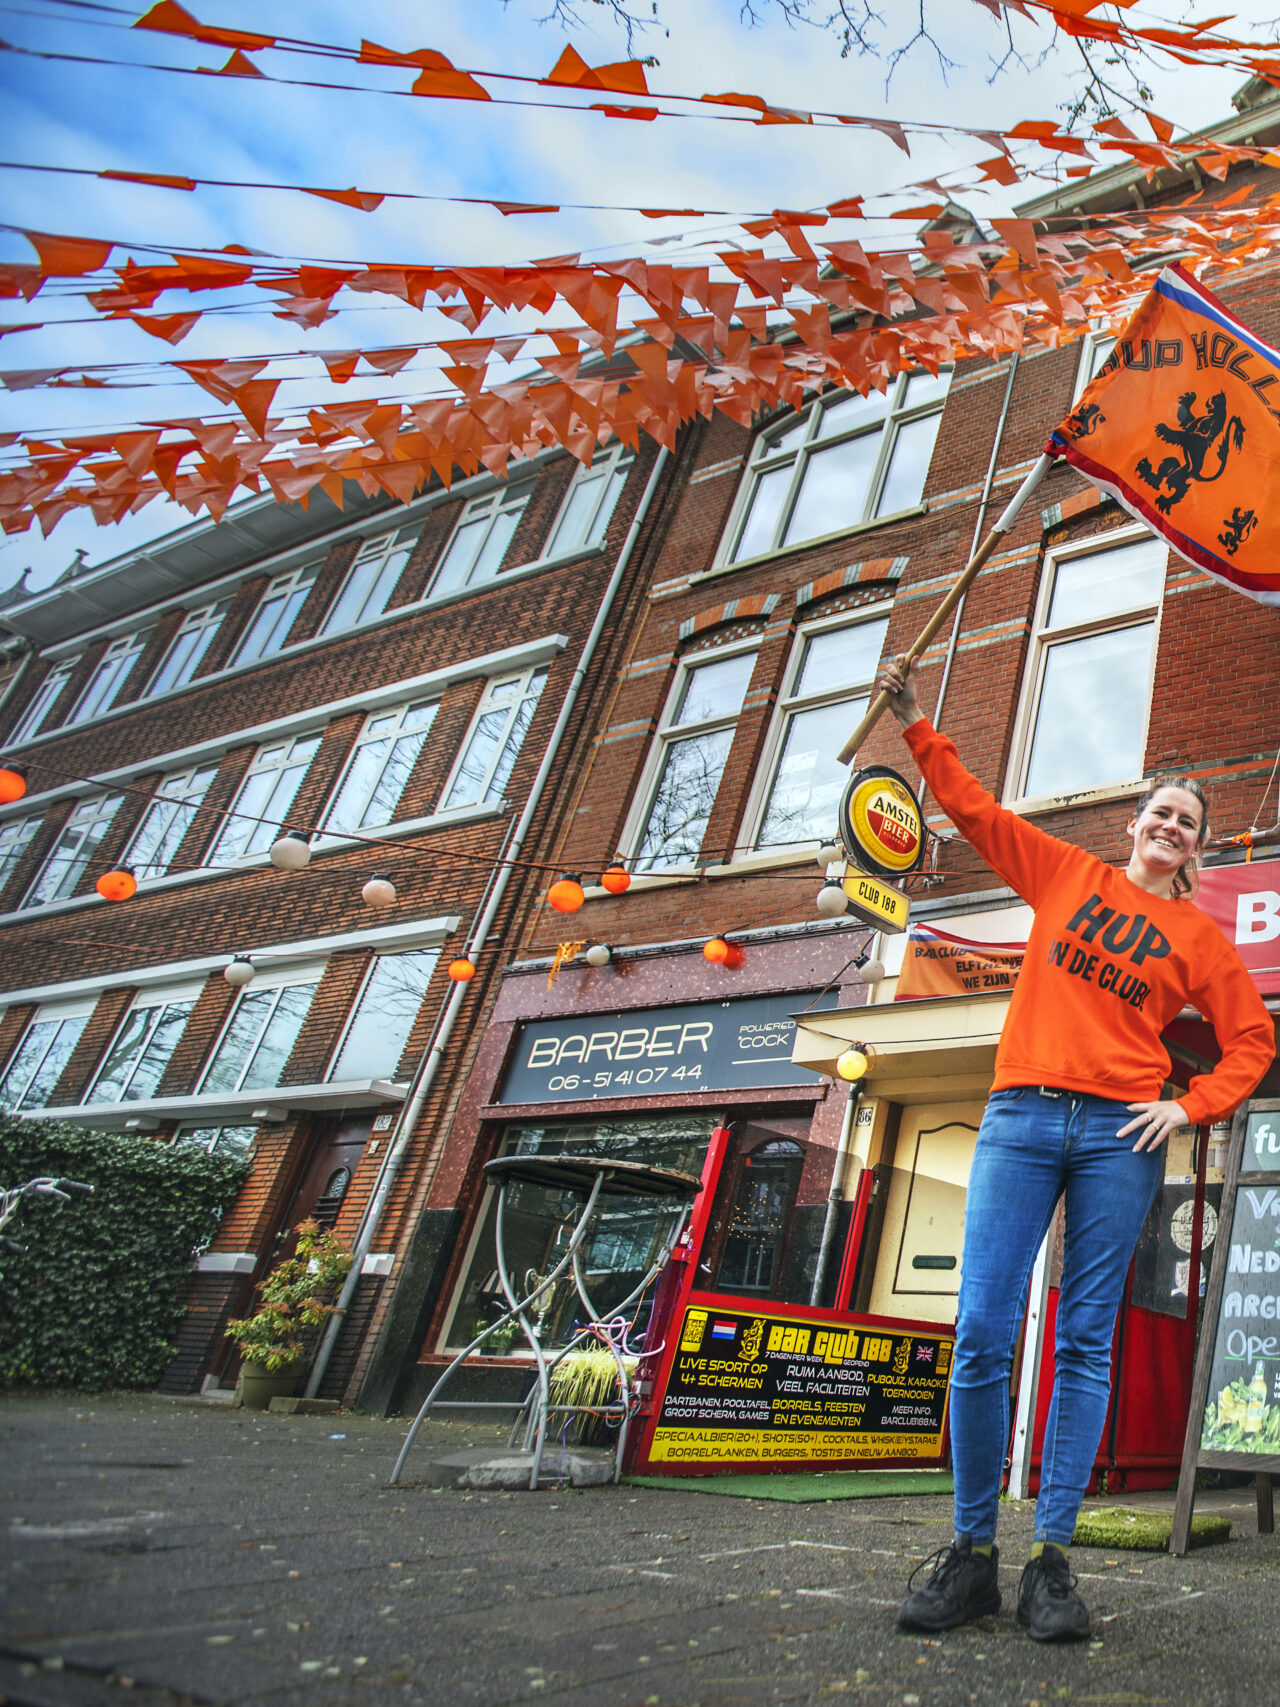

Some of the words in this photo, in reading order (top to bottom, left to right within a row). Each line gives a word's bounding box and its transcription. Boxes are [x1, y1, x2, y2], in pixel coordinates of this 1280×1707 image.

[1095, 338, 1184, 380] HUP
[873, 796, 918, 836] AMSTEL
[884, 819, 910, 843] BIER
[859, 882, 880, 905] CLUB
[881, 895, 897, 914] 188
[1065, 893, 1172, 966] HUP
[938, 946, 967, 958] CLUB
[1048, 940, 1070, 967] IN
[1067, 948, 1099, 982] DE
[962, 976, 980, 989] WE
[983, 973, 1010, 987] ZIJN
[740, 1021, 796, 1033] POWERED
[527, 1022, 713, 1068] BARBER
[635, 1067, 669, 1083] 07
[671, 1064, 702, 1081] 44
[861, 1336, 893, 1363] 188
[680, 1357, 707, 1370] LIVE
[708, 1360, 751, 1373] SPORT
[751, 1363, 768, 1374] OP
[770, 1352, 792, 1360] DAGEN
[792, 1354, 806, 1362] PER
[806, 1355, 824, 1363] WEEK
[843, 1359, 870, 1367] GEOPEND
[681, 1373, 697, 1386] 4+
[698, 1375, 764, 1390] SCHERMEN
[787, 1365, 815, 1378] RUIM
[817, 1367, 865, 1382] AANBOD,
[867, 1373, 906, 1386] PUBQUIZ,
[907, 1377, 948, 1389] KARAOKE
[776, 1380, 805, 1393] VEEL
[806, 1382, 870, 1396] FACILITEITEN
[882, 1388, 935, 1400] TOERNOOIEN
[664, 1395, 722, 1407] DARTBANEN,
[722, 1399, 771, 1410] POOLTAFEL,
[772, 1399, 823, 1413] BORRELS,
[824, 1401, 866, 1413] FEESTEN
[892, 1405, 913, 1415] MEER
[914, 1406, 932, 1415] INFO:
[664, 1408, 697, 1418] GROOT
[698, 1409, 738, 1420] SCHERM,
[738, 1410, 770, 1420] GAMES
[773, 1413, 789, 1425] EN
[790, 1414, 861, 1427] EVENEMENTEN
[881, 1416, 939, 1427] BARCLUB188.NL
[823, 1434, 869, 1445] COCKTAILS,
[667, 1448, 760, 1458] BORRELPLANKEN,
[762, 1448, 809, 1458] BURGERS,
[844, 1448, 856, 1457] EN
[857, 1448, 883, 1457] NIEUW
[884, 1448, 918, 1457] AANBOD
